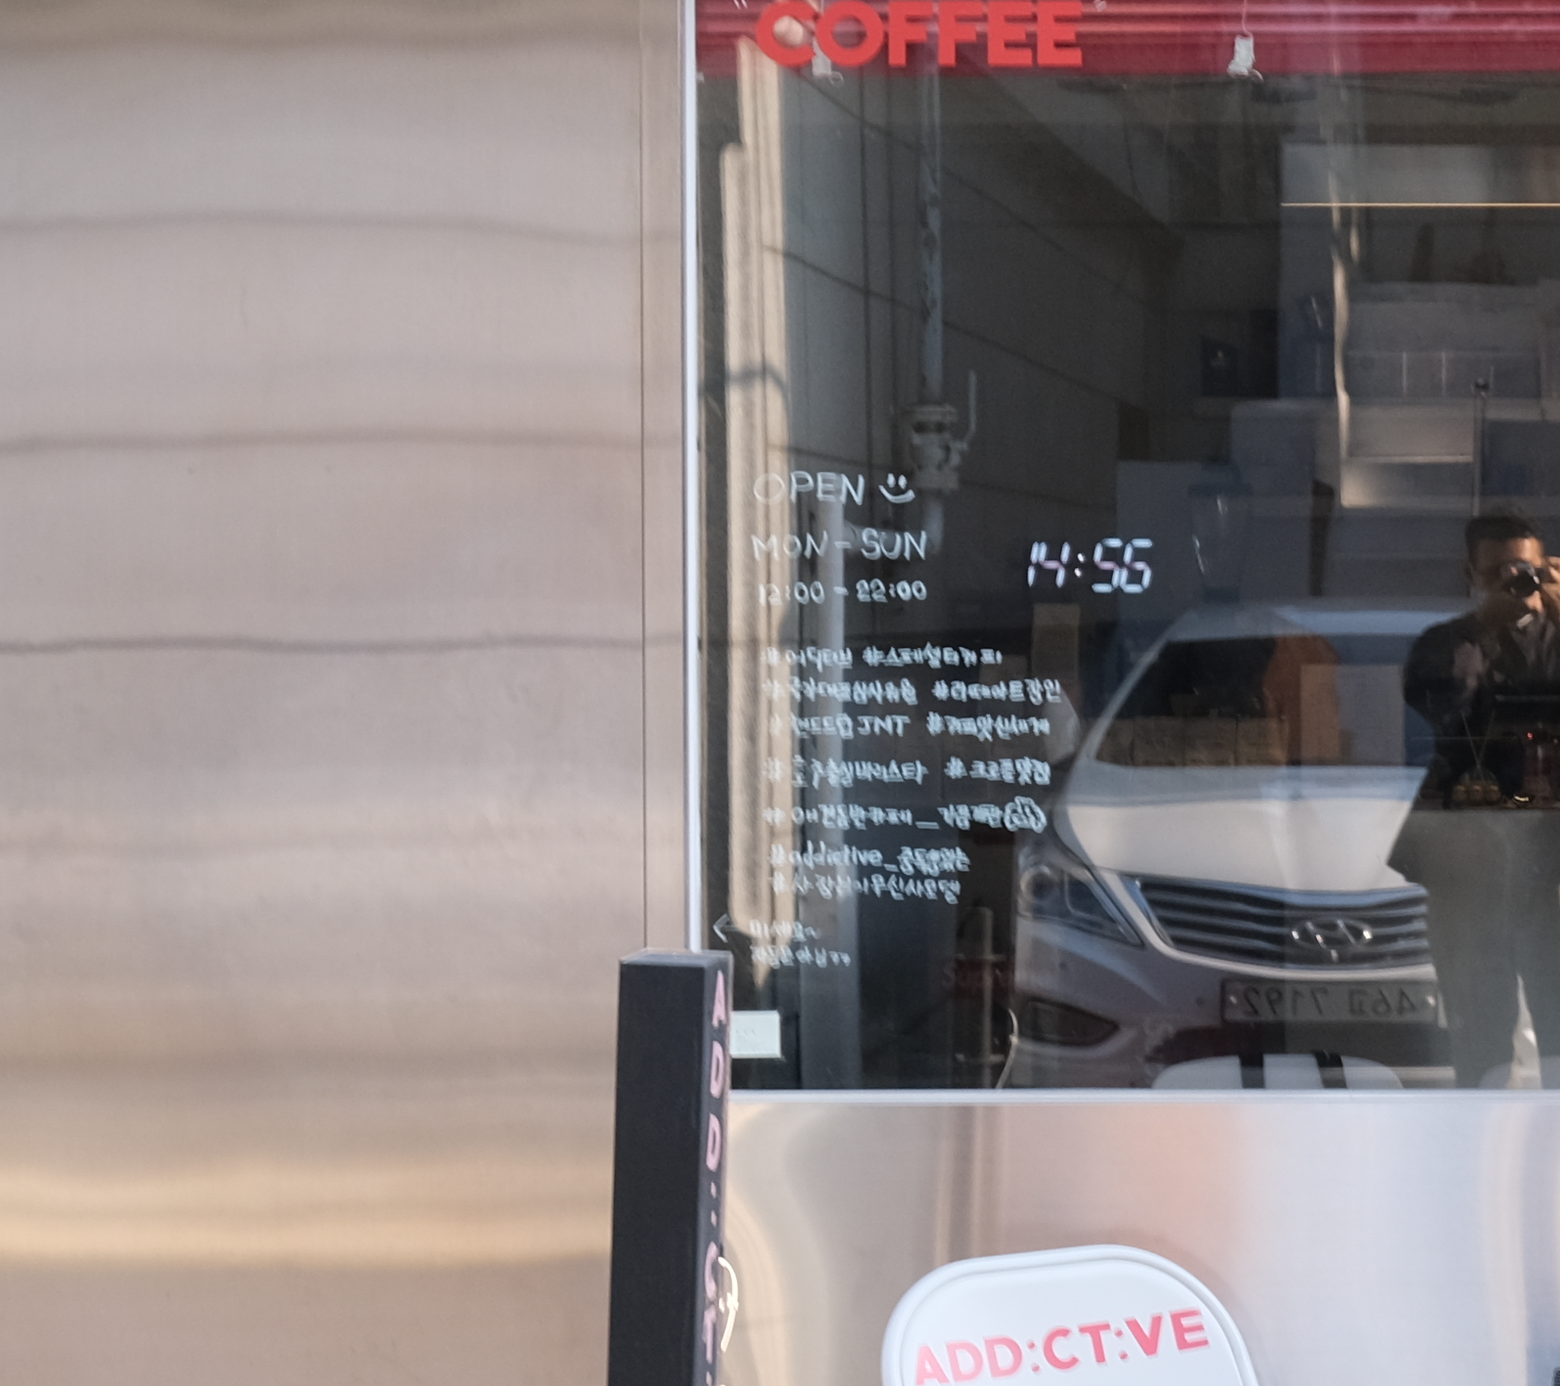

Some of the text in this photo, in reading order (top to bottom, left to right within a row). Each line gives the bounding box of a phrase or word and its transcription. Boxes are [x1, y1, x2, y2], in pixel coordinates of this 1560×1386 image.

[752, 470, 865, 506] OPEN
[1027, 537, 1153, 595] 14:56
[915, 1308, 1211, 1386] ADD:CT:VE
